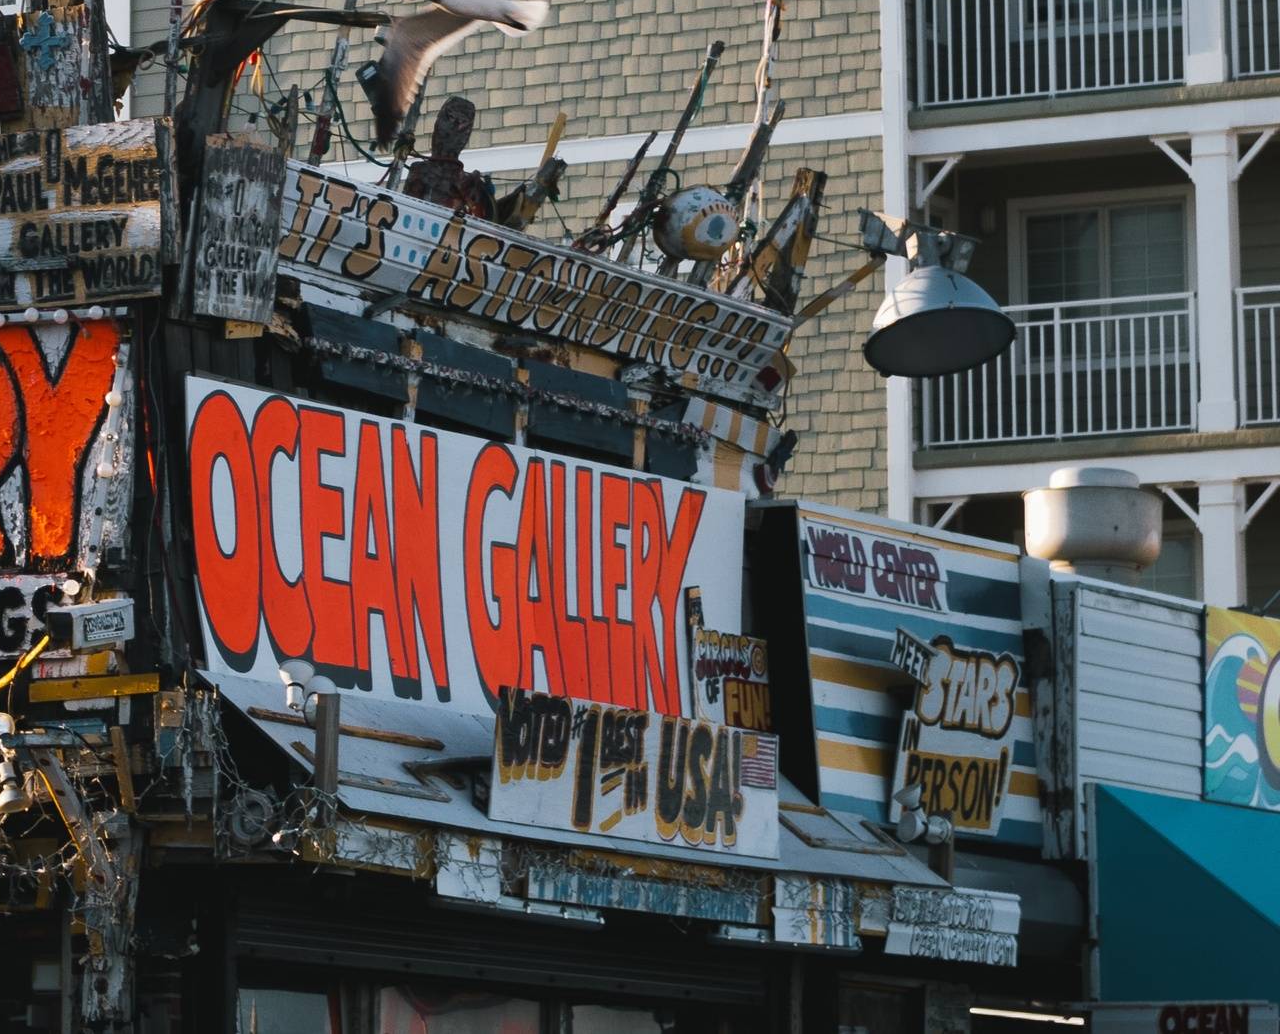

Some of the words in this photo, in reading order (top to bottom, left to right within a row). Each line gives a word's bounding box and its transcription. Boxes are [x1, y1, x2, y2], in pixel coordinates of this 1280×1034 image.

[19, 219, 128, 258] GALLERY
[279, 169, 399, 280] IT'S
[189, 390, 451, 702] OCEAN
[464, 442, 707, 718] GALLERY
[807, 526, 868, 594] WORLD
[872, 540, 943, 611] CENTER
[891, 630, 930, 687] MEET
[918, 637, 1017, 740] STARS
[600, 708, 650, 771] BEST
[903, 717, 920, 752] IN
[624, 763, 649, 815] IN
[654, 716, 745, 847] USA!
[906, 746, 1009, 822] PERSON!
[1159, 1003, 1249, 1034] OCEAN
